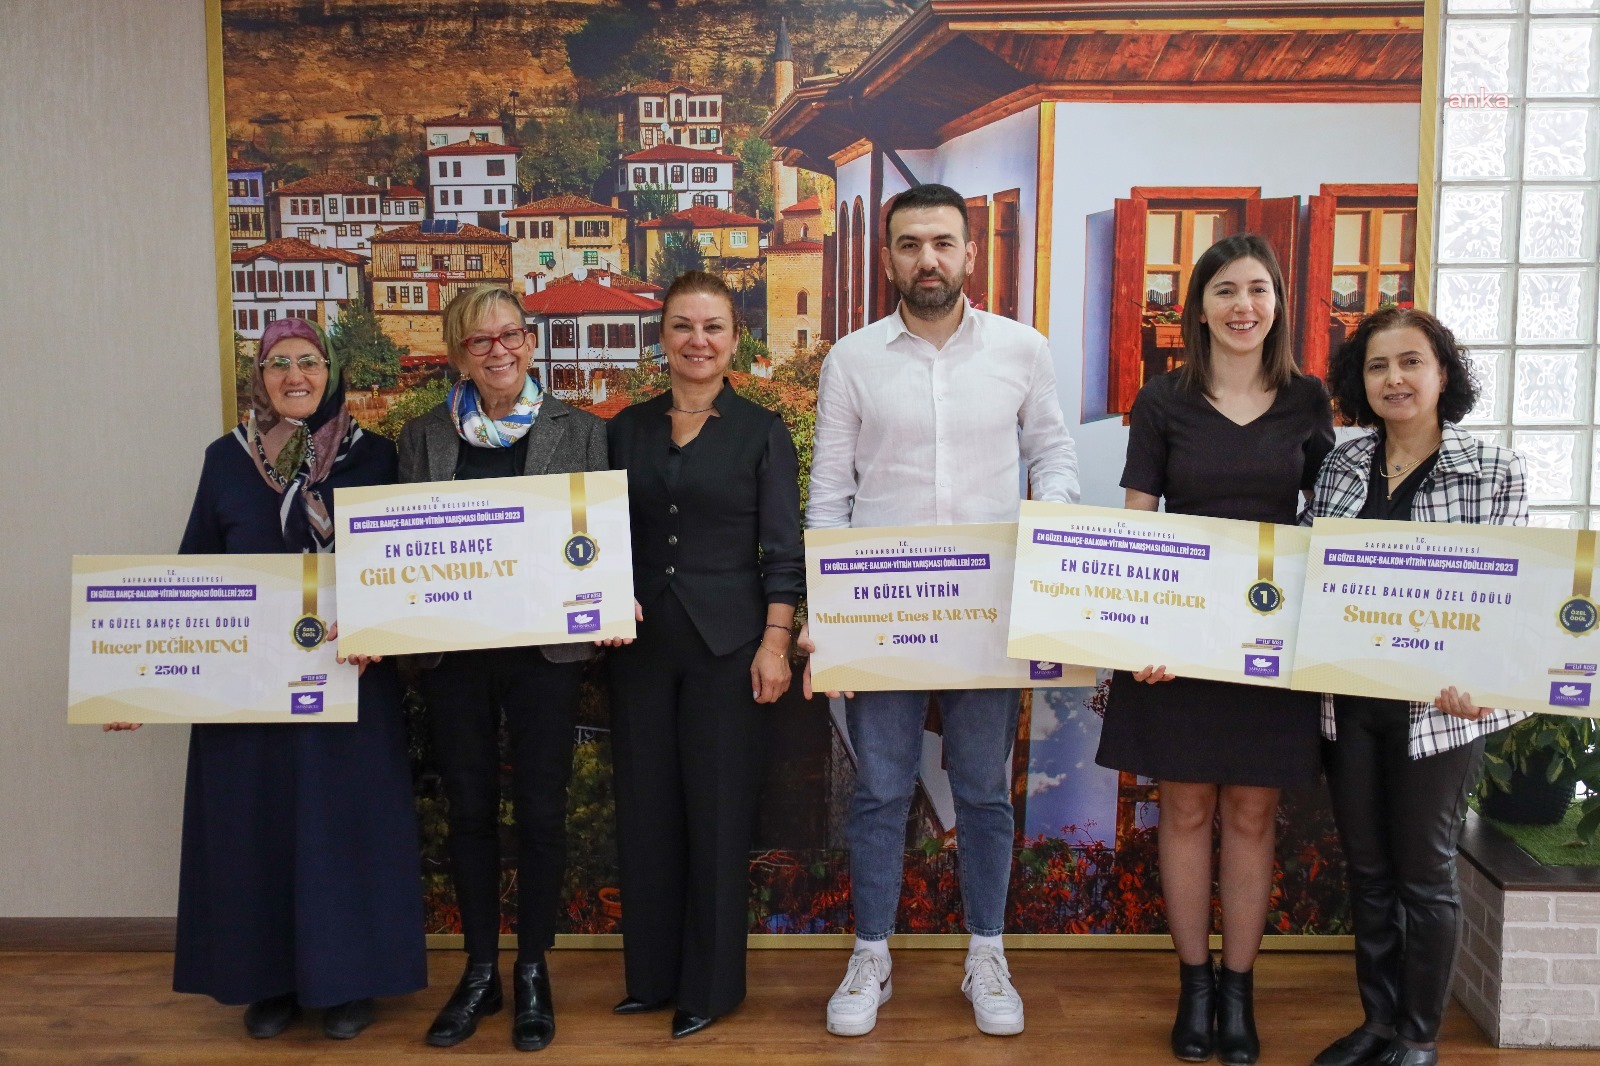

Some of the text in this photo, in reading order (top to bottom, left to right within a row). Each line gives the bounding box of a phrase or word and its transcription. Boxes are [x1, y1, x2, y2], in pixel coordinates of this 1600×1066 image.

[386, 501, 489, 512] SAFRANBOLU BELEDİYESİ
[354, 522, 361, 530] EN
[362, 520, 379, 529] GÜZEL
[445, 515, 476, 525] YARIŞMASI
[477, 511, 504, 522] ÖDÜLLERİ
[505, 512, 520, 520] 2023
[386, 538, 492, 558] EN GÜZEL BAHÇE
[576, 544, 584, 558] 1
[1037, 533, 1045, 542] EN
[1046, 534, 1063, 543] GÜZEL
[1129, 541, 1161, 552] YARIŞMASI
[1161, 544, 1189, 555] ÖDÜLLERİ
[1190, 548, 1206, 556] 2023
[1365, 542, 1480, 554] SAFRANBOLU BELEDİYESİ
[855, 548, 905, 556] SAFRANBOLU
[832, 562, 849, 570] GÜZEL
[912, 560, 943, 570] YARIŞMASI
[943, 557, 970, 567] ÖDÜLLERİ
[971, 558, 986, 566] 2023
[1329, 554, 1337, 562] EN
[1337, 553, 1355, 563] GÜZEL
[1428, 559, 1462, 570] YARIŞMASI
[1463, 560, 1494, 571] ÖDÜLLERİ
[1495, 563, 1513, 572] 2023
[360, 560, 518, 586] Gül CANBULAT
[1062, 559, 1179, 582] EN GÜZEL BALKON
[99, 589, 115, 598] GÜZEL
[179, 589, 209, 599] YARIŞMASI
[210, 588, 237, 597] ÖDÜLLERİ
[425, 591, 472, 603] 5000 tl
[854, 582, 959, 600] EN GÜZEL VİTRİN
[1030, 579, 1206, 610] Tuğba MORALI GÜLER
[1260, 591, 1268, 604] 1
[1323, 583, 1512, 605] EN GÜZEL BALKON ÖZEL ÖDÜLÜ
[816, 608, 998, 624] Muhammet Enes KARATAŞ
[1100, 611, 1136, 624] 5000
[1343, 605, 1481, 633] Suna ÇAKIR
[92, 617, 250, 630] EN GÜZEL BAHÇE ÖZEL ÖDÜLÜ
[92, 635, 248, 654] Hacer DEĞİRMENCİ
[893, 634, 926, 644] 5000
[1392, 637, 1444, 651] 2500 tl
[154, 665, 200, 675] 2500 tl
